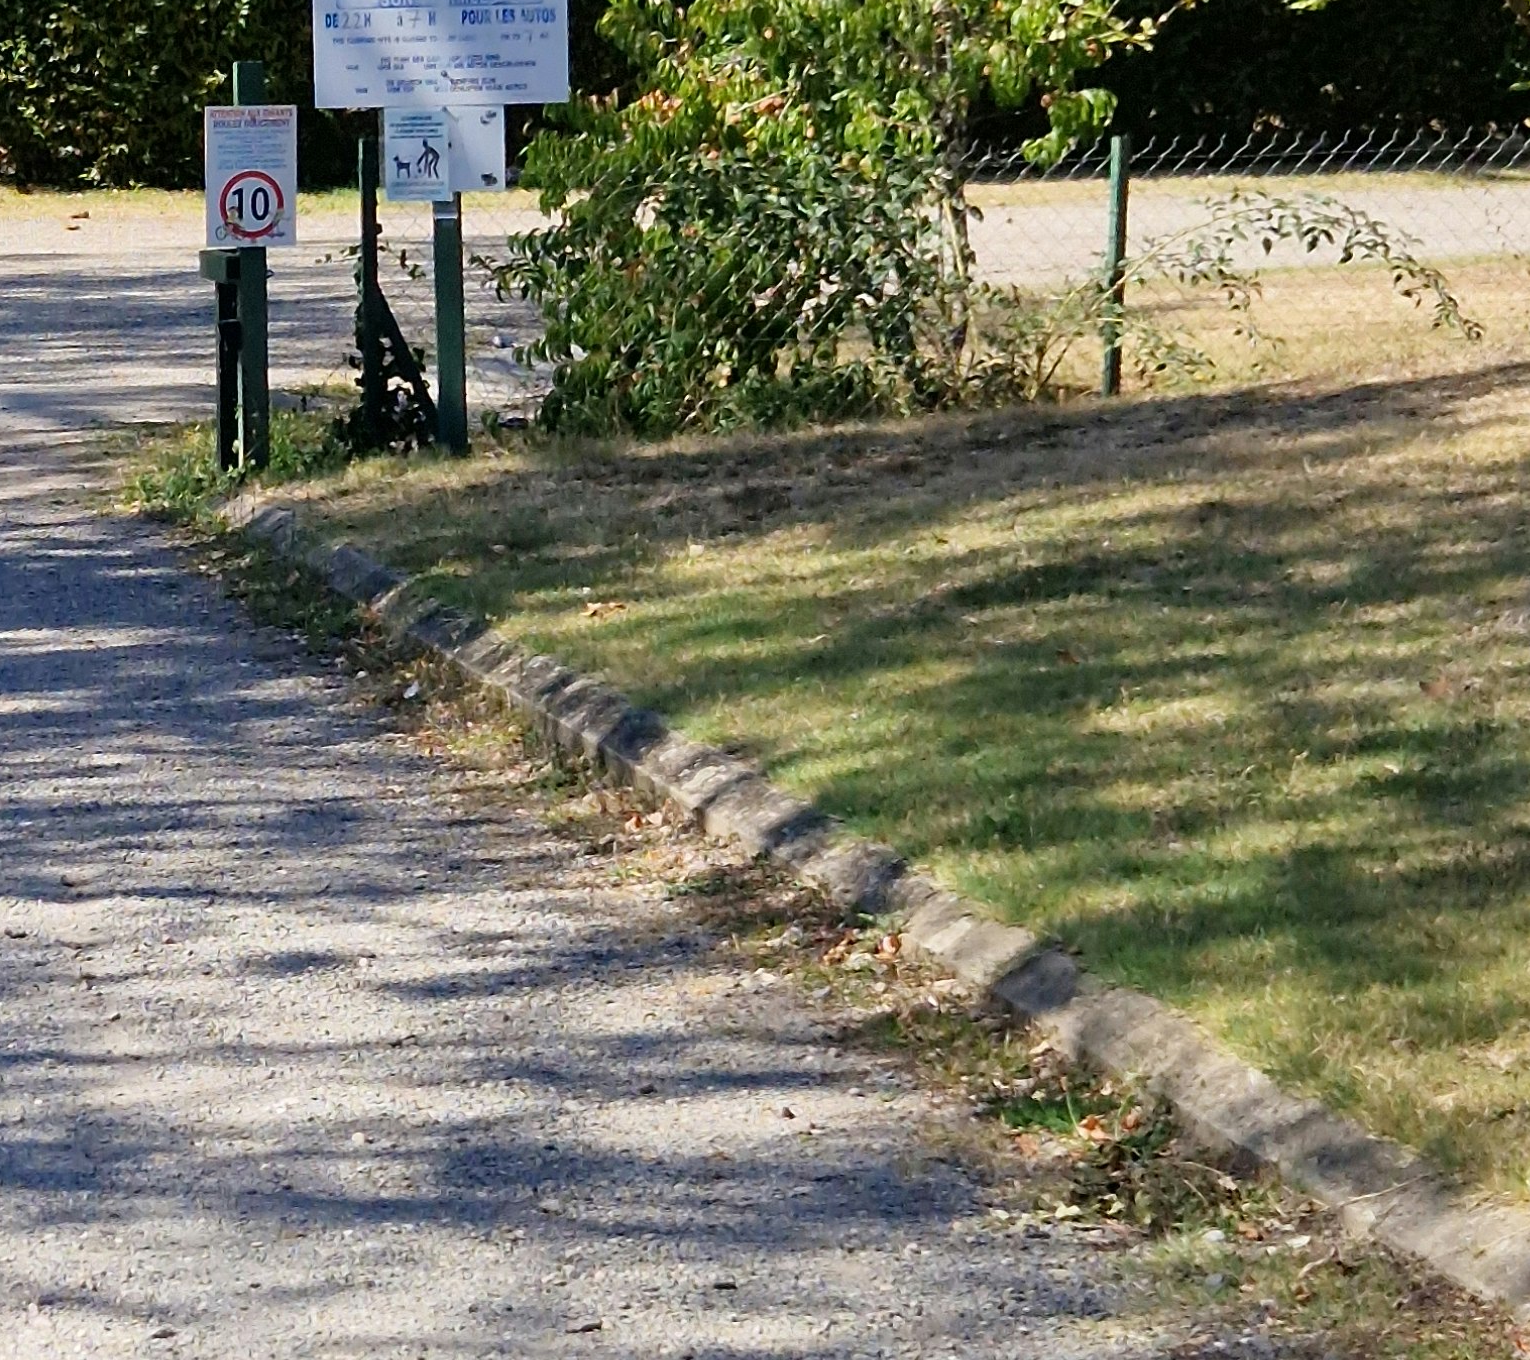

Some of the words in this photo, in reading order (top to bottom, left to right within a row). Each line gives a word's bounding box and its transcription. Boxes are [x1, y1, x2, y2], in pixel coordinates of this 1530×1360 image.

[325, 13, 339, 29] DE
[461, 9, 492, 25] POUR
[495, 9, 516, 24] LES
[520, 8, 557, 24] AUTOS
[231, 186, 270, 221] 10
